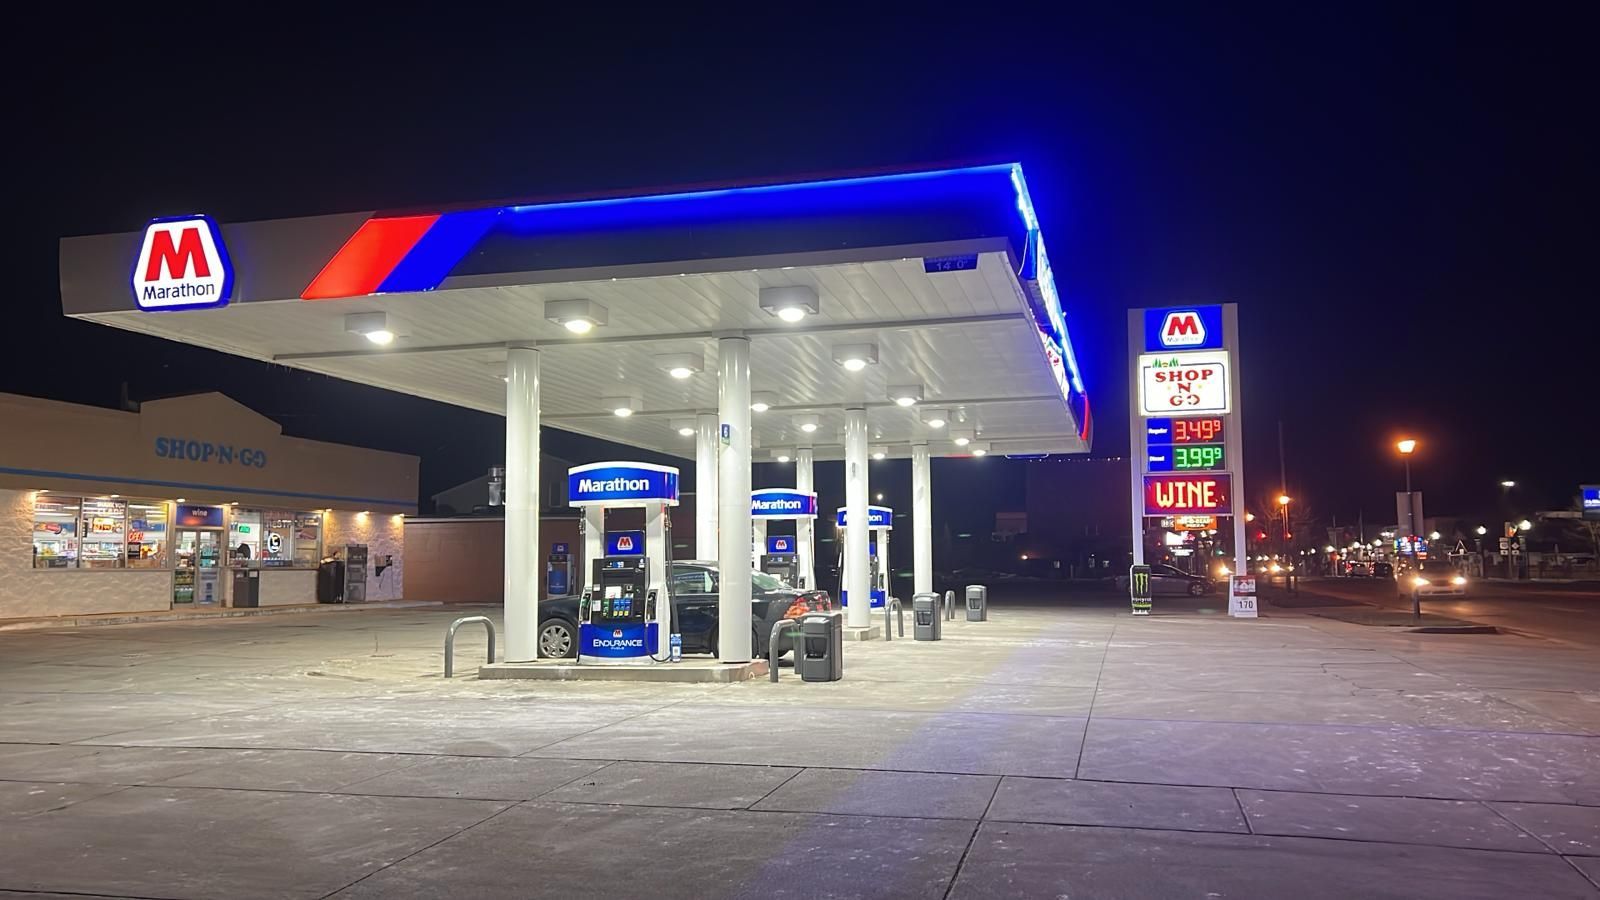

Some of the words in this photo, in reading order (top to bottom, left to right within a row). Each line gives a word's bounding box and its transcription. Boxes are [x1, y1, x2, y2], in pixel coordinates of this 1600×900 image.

[145, 228, 211, 282] M
[143, 283, 214, 300] Marathon
[1167, 315, 1199, 335] M
[1155, 369, 1213, 383] SHOP
[1177, 382, 1192, 394] N
[1169, 394, 1200, 406] GO
[578, 477, 650, 493] Marathon
[1156, 481, 1217, 508] WINE
[751, 499, 801, 510] Marathon
[192, 508, 208, 517] wine
[593, 639, 643, 648] ENDURANCE
